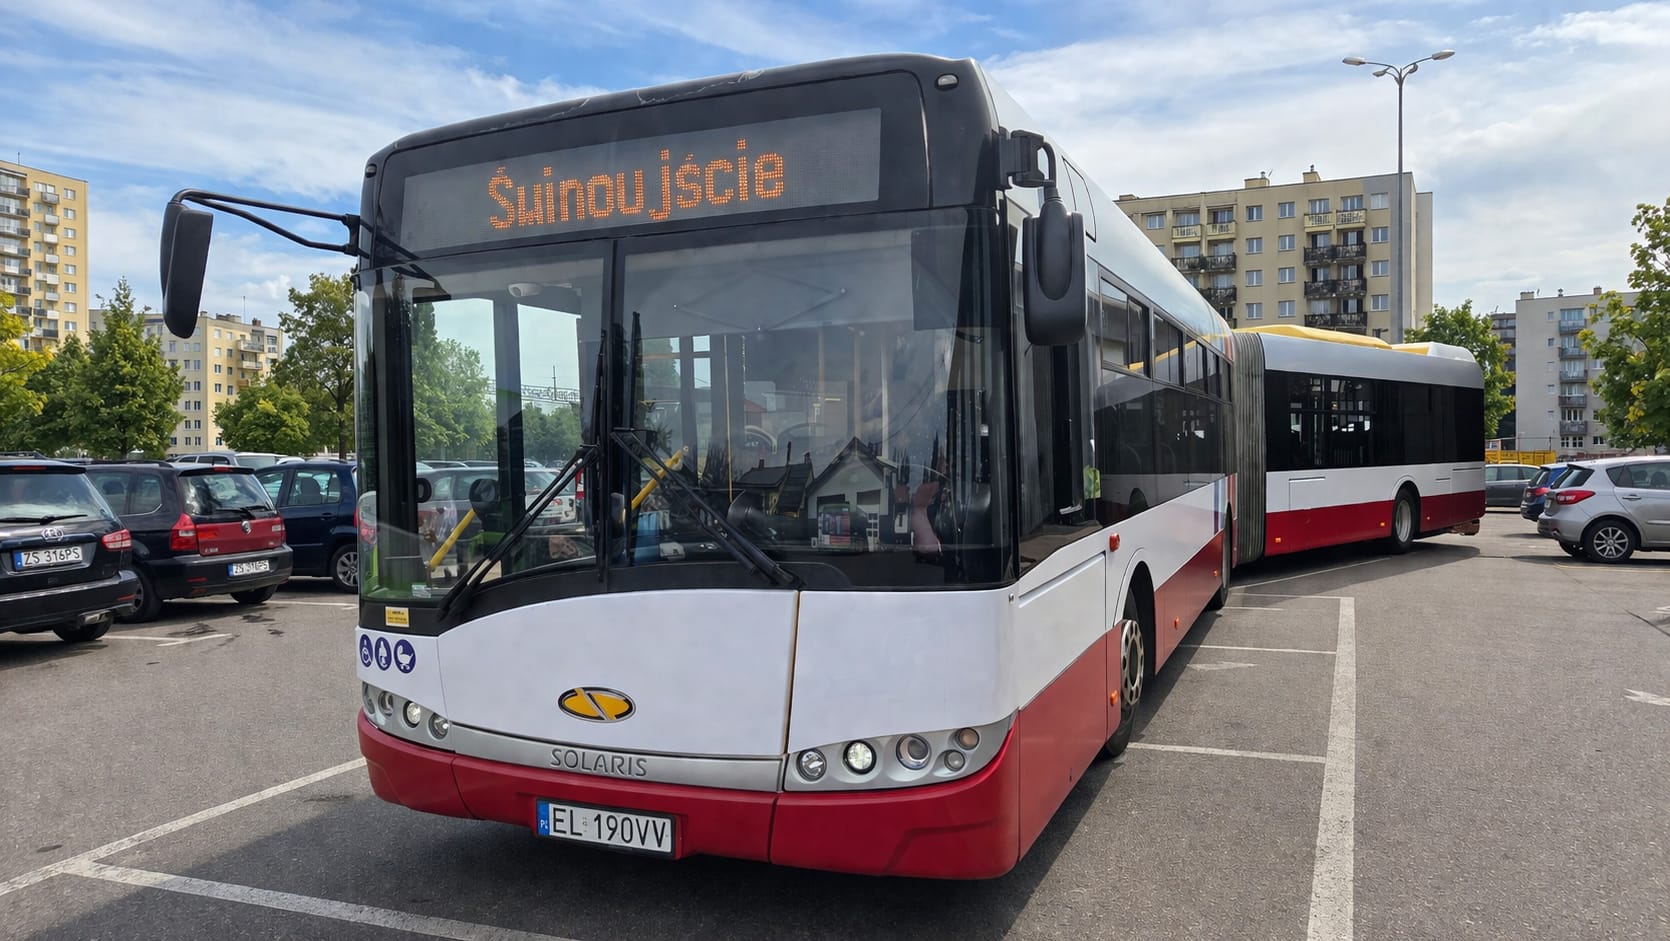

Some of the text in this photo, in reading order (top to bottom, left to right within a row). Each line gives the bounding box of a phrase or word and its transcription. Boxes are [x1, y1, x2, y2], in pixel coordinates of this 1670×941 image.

[488, 138, 785, 229] Świnoujście
[23, 547, 80, 566] ZS 316PS
[550, 748, 648, 777] SOLARIS
[553, 807, 666, 848] EL 190VV
